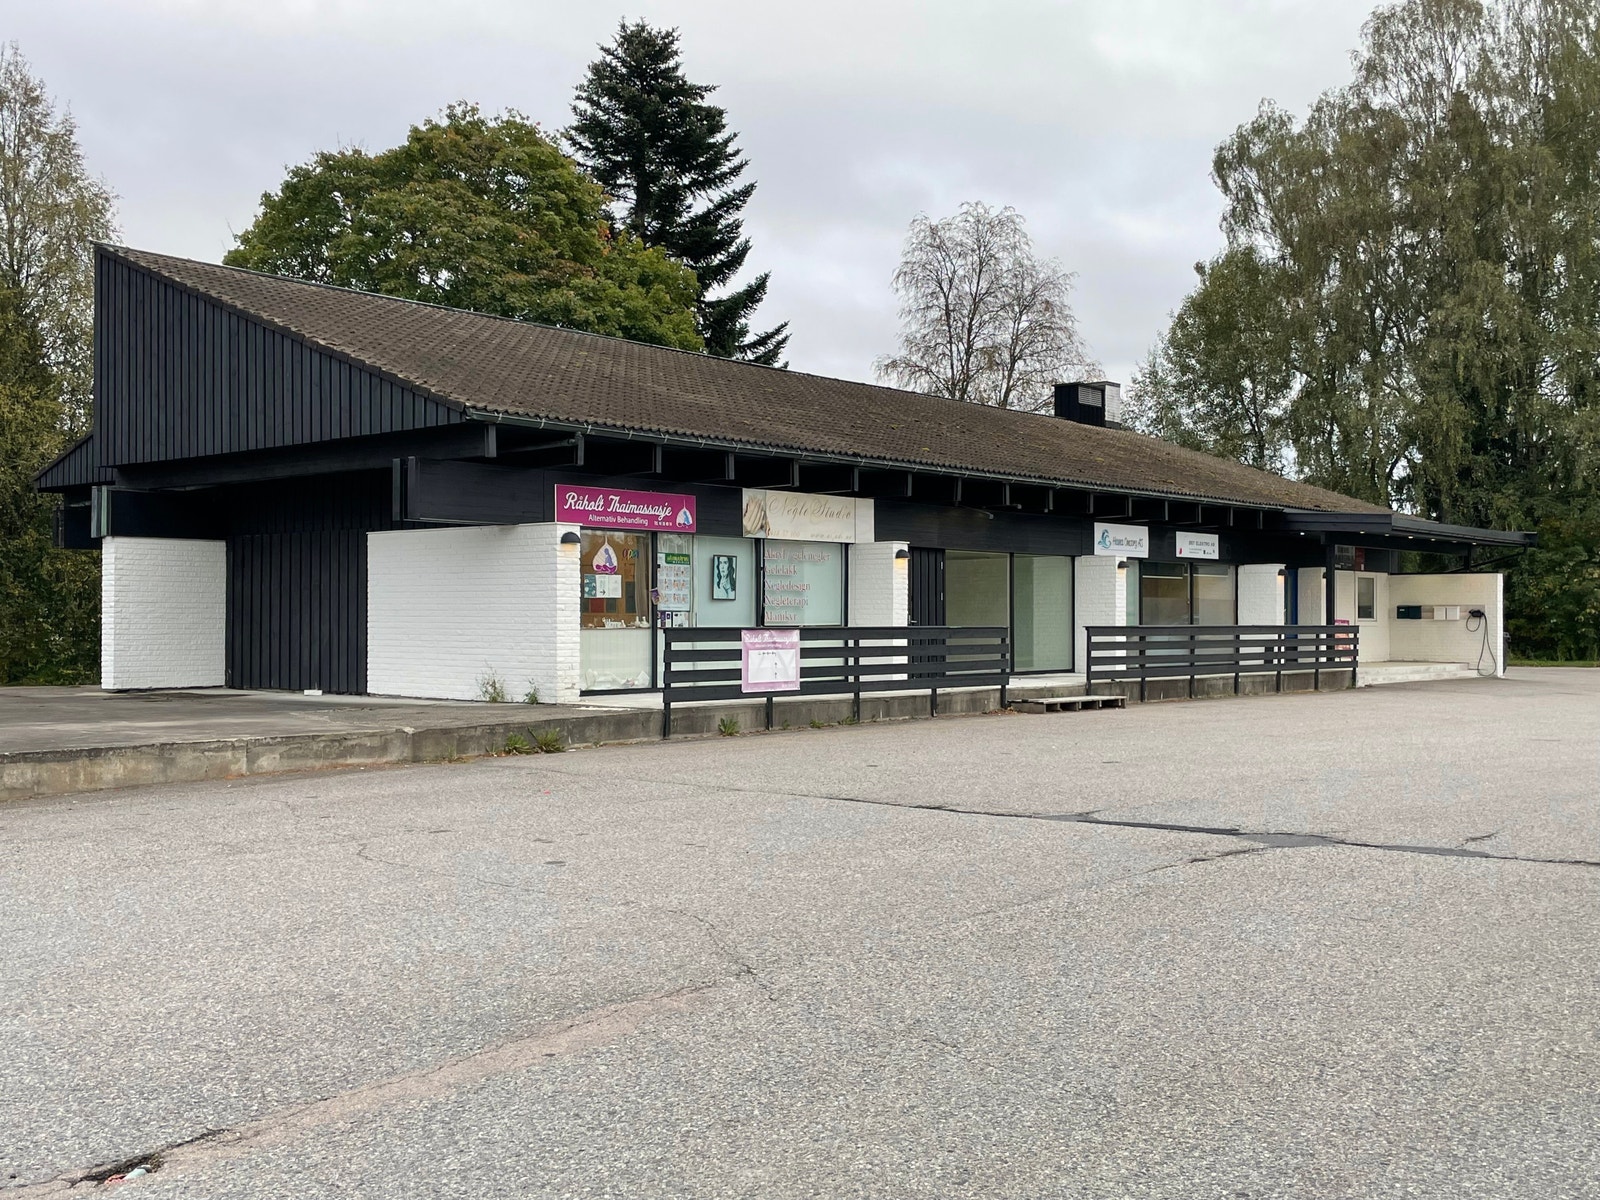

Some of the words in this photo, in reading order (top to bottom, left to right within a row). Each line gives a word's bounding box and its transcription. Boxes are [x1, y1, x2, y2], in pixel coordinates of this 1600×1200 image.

[563, 491, 605, 511] Råholt
[607, 495, 673, 521] Thaimassasje
[588, 513, 616, 523] Alternativ
[617, 515, 649, 526] Behandling
[764, 580, 811, 592] Negledesign
[764, 595, 809, 609] Negleterapi
